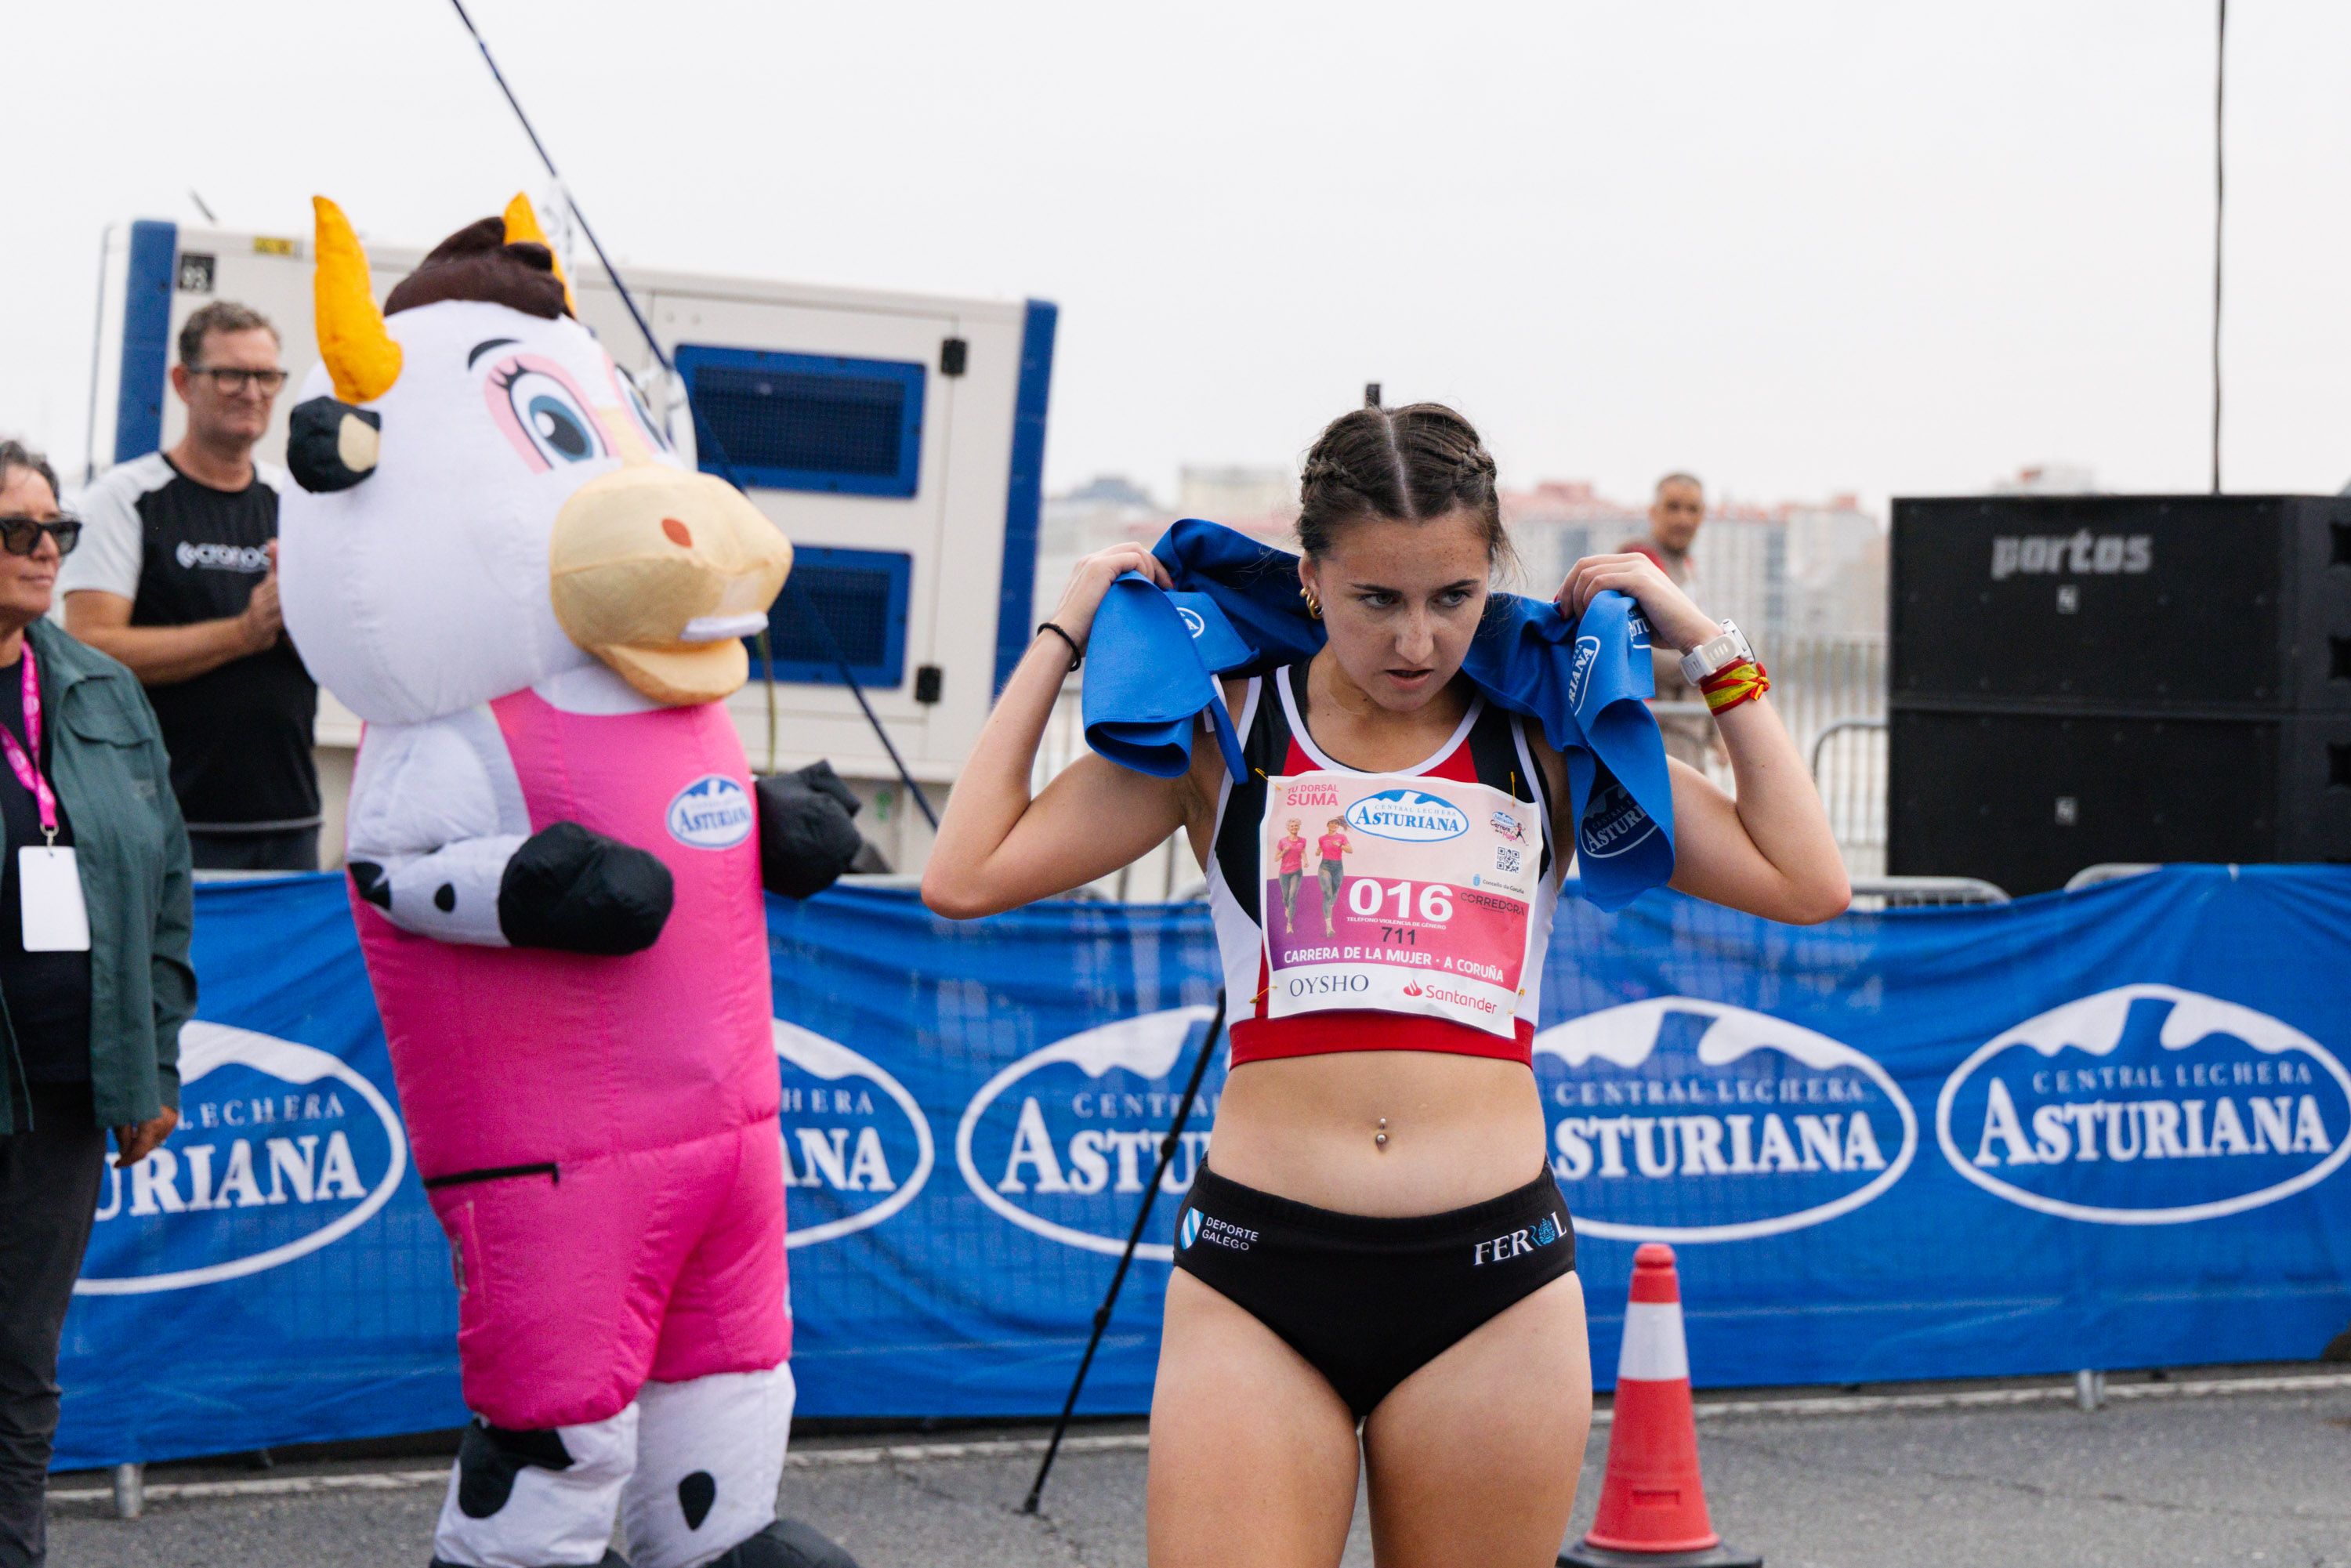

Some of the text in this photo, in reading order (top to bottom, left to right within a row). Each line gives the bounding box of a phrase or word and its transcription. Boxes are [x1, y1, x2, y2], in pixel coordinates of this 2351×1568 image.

[1568, 647, 1595, 708] RIANA
[1286, 792, 1339, 806] SUMA
[1301, 783, 1339, 792] DORSAL
[1354, 806, 1460, 832] ASTURIANA
[1374, 803, 1457, 817] CENTRAL LECHERA
[1483, 878, 1502, 888] Concello
[1509, 885, 1524, 894] Coruña
[1349, 878, 1453, 922] 016
[1460, 892, 1524, 916] CORREDORA
[1379, 918, 1411, 926] VIOLENCIA
[1381, 926, 1415, 945] 711
[1284, 947, 1504, 983] CARRERA DE LA MUJER A CORUÑA
[1289, 974, 1369, 998] OYSHO
[1425, 984, 1498, 1015] Santander
[2033, 1060, 2312, 1094] CENTRAL LECHERA
[1555, 1077, 1864, 1107] CENTRAL LECHERA
[1973, 1077, 2332, 1168] ASTURIANA
[1553, 1110, 1887, 1180] STURIANA
[1201, 1229, 1249, 1251] GALEGO
[1206, 1216, 1259, 1242] DEPORTE
